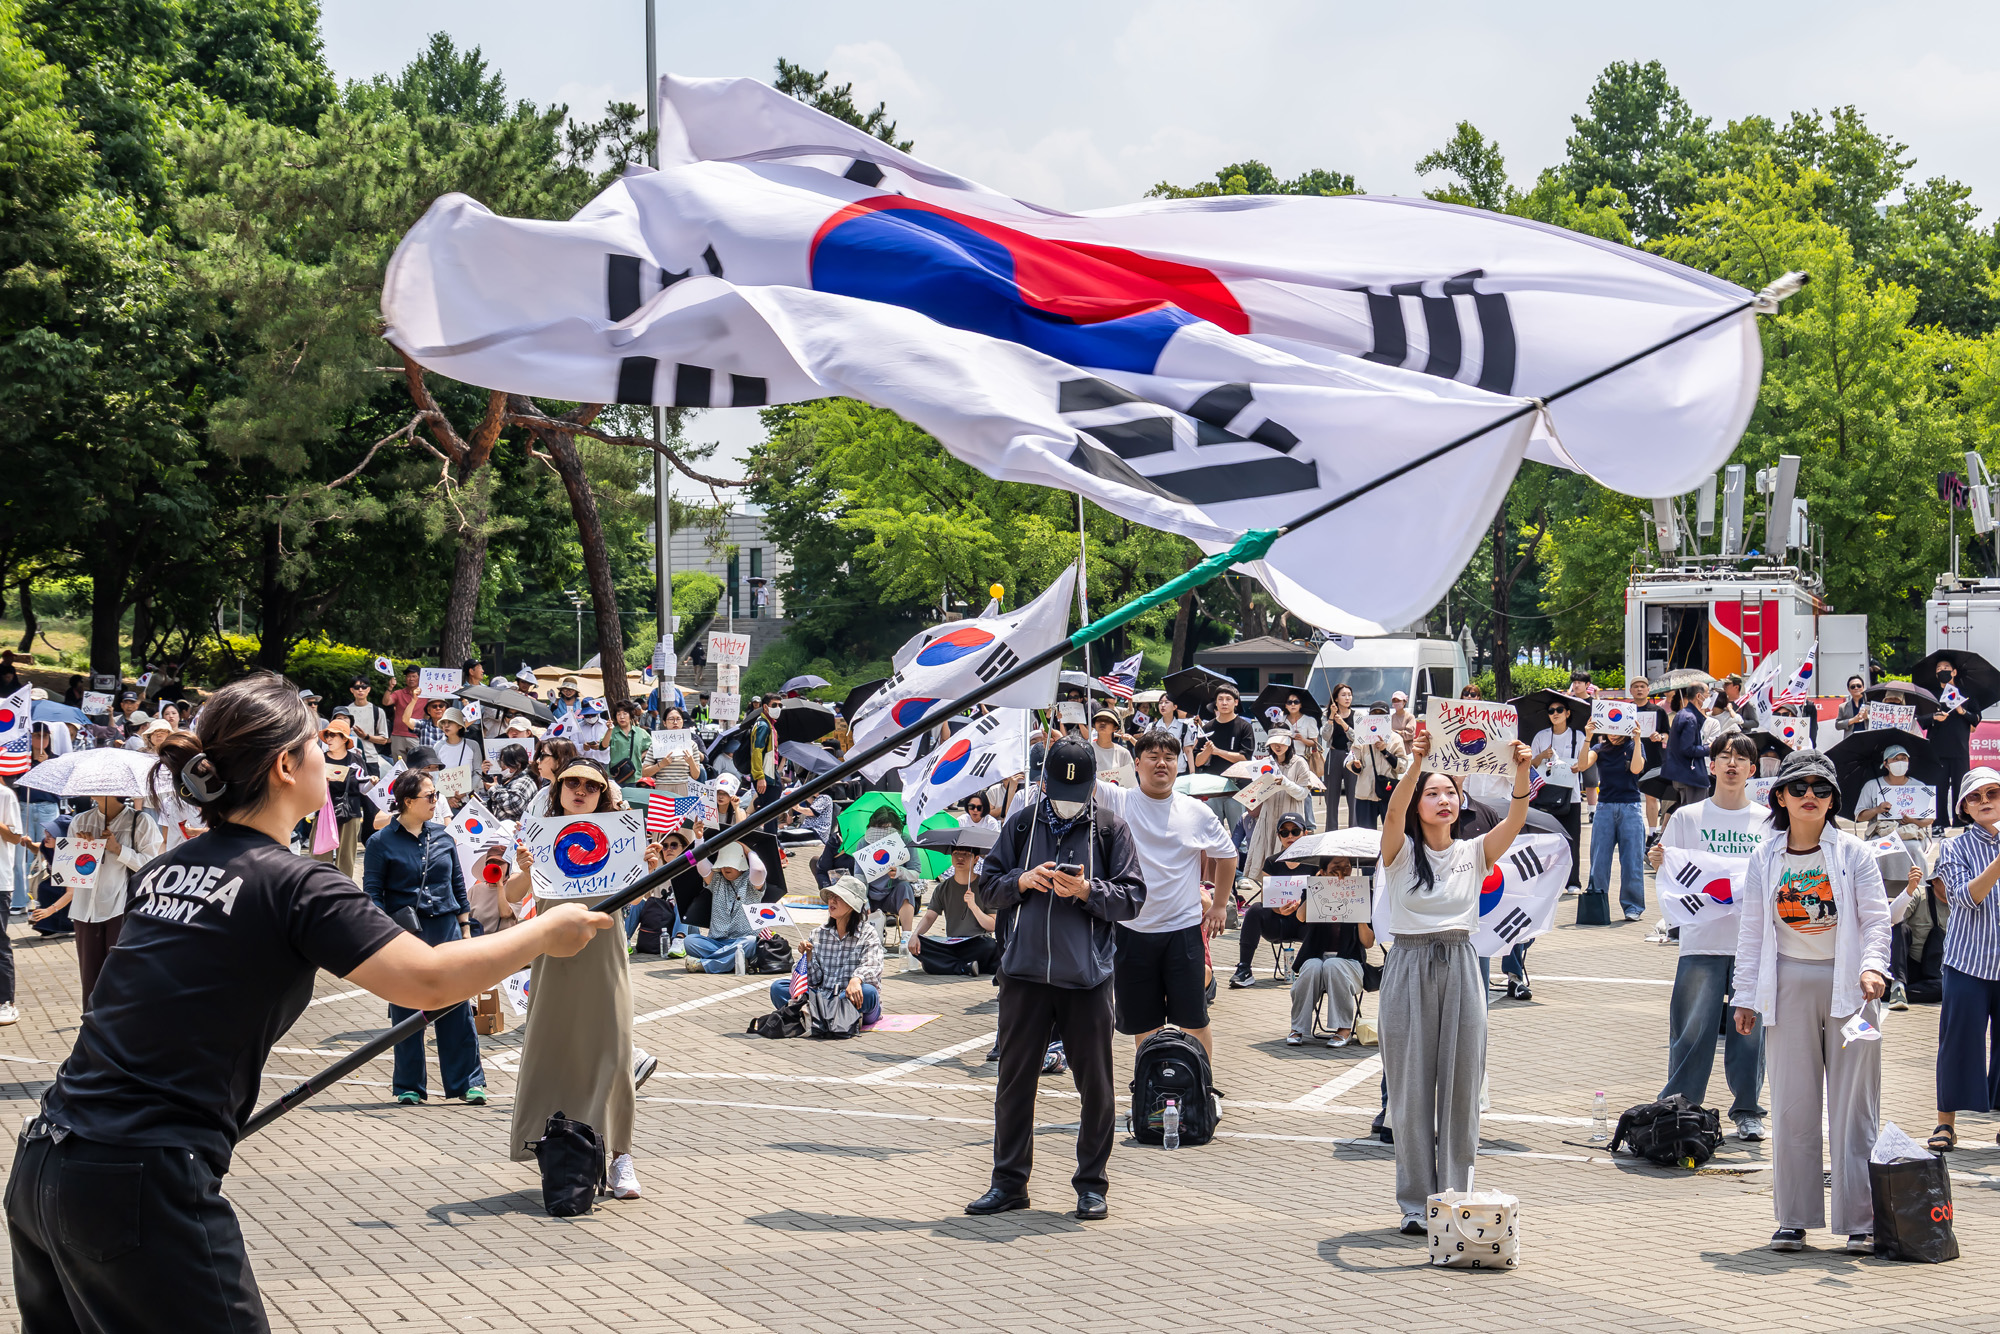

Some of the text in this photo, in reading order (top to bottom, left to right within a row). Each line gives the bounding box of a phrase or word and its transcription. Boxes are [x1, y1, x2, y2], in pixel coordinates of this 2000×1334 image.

[711, 637, 746, 655] 재선거
[1439, 702, 1490, 725] 부정선거
[1871, 703, 1895, 715] 당일투표
[1428, 752, 1470, 772] 당일투표
[1066, 762, 1076, 781] B
[1700, 829, 1762, 844] Maltese
[611, 836, 636, 854] 선거
[562, 872, 616, 894] 재선거!
[1274, 879, 1304, 888] STOP
[136, 865, 244, 915] KOREA
[140, 893, 204, 924] ARMY
[1430, 1207, 1438, 1218] 9
[1495, 1213, 1501, 1224] 3
[1446, 1223, 1449, 1233] 1
[1477, 1228, 1485, 1238] 7
[1434, 1235, 1439, 1246] 3
[1456, 1241, 1464, 1252] 6
[1492, 1243, 1500, 1254] 9
[1472, 1259, 1480, 1269] 8
